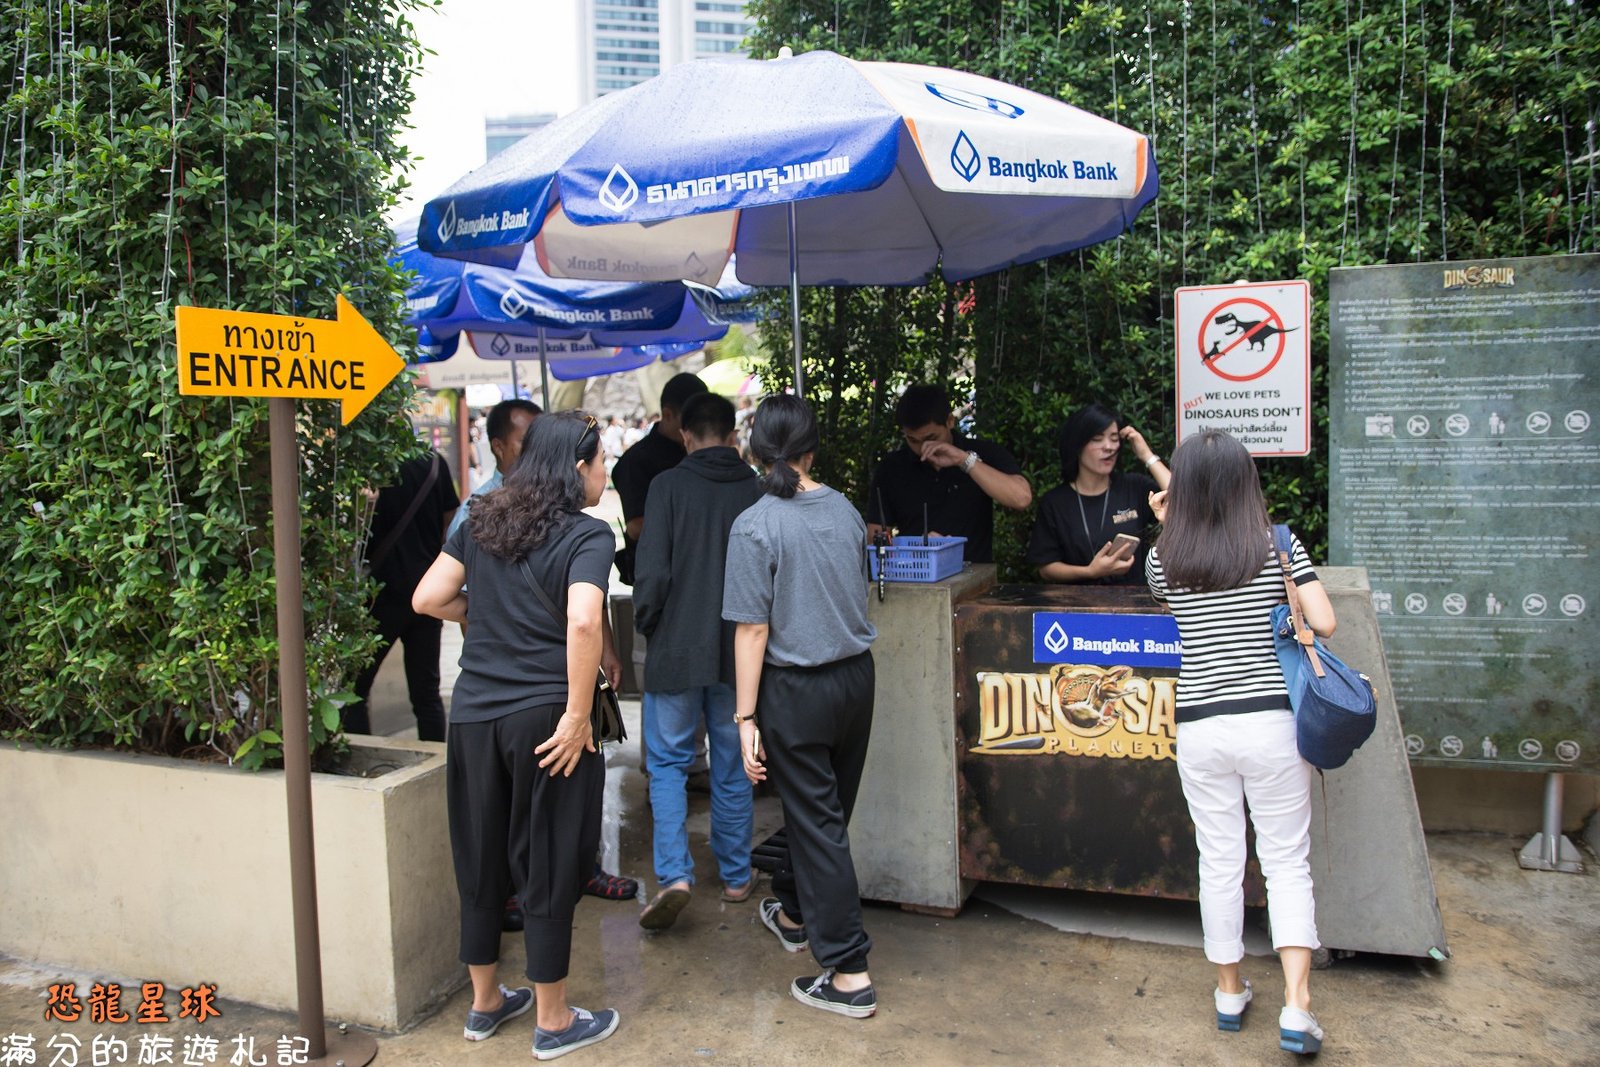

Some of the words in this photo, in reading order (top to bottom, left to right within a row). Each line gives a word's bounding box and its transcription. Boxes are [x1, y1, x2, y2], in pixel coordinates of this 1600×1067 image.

[987, 156, 1069, 183] Bangkok
[1072, 160, 1119, 181] Bank
[646, 155, 850, 204] ธนาคารกรุงเทพ
[456, 211, 500, 238] Bangkok
[501, 207, 530, 231] Bank
[609, 307, 655, 322] Bank
[223, 320, 315, 353] ทางเข้า
[514, 342, 567, 354] Bankok
[189, 351, 366, 391] ENTRANCE
[1183, 396, 1204, 410] BUT
[1205, 391, 1221, 400] WE
[1224, 391, 1250, 400] LOVE
[1254, 389, 1281, 399] PETS
[1184, 408, 1259, 420] DINOSAURS
[1262, 406, 1302, 417] DON'T
[1072, 636, 1140, 655] Bangkok
[976, 665, 1178, 744] DINOSA
[1049, 736, 1164, 754] PLANET
